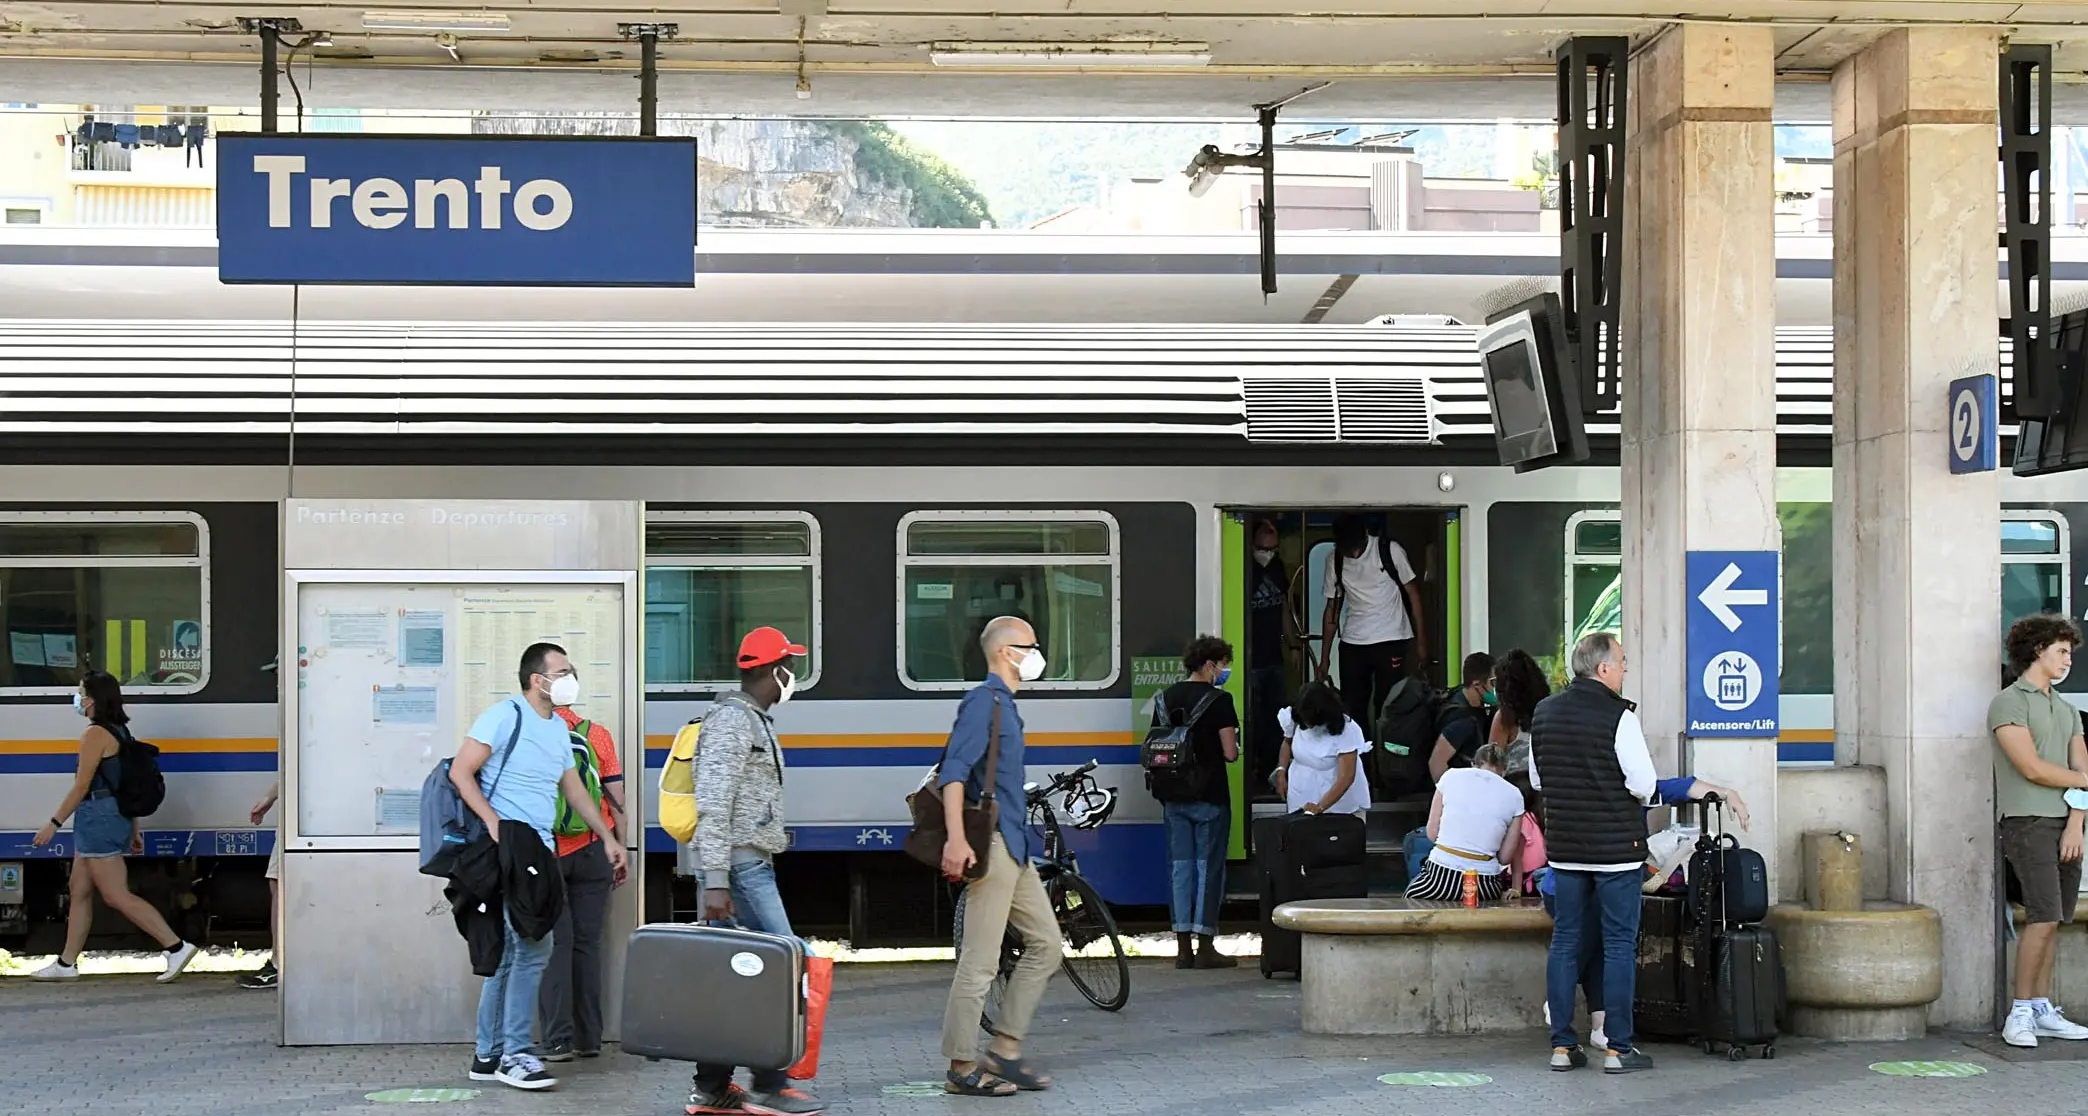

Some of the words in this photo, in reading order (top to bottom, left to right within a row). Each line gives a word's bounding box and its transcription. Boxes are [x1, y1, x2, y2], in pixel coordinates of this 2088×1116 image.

[253, 155, 574, 231] Trento
[1959, 401, 1973, 449] 2
[297, 506, 405, 525] Partenze
[431, 508, 569, 528] Departures
[1133, 660, 1185, 672] SALITA
[1690, 718, 1776, 731] Ascensore/Lift
